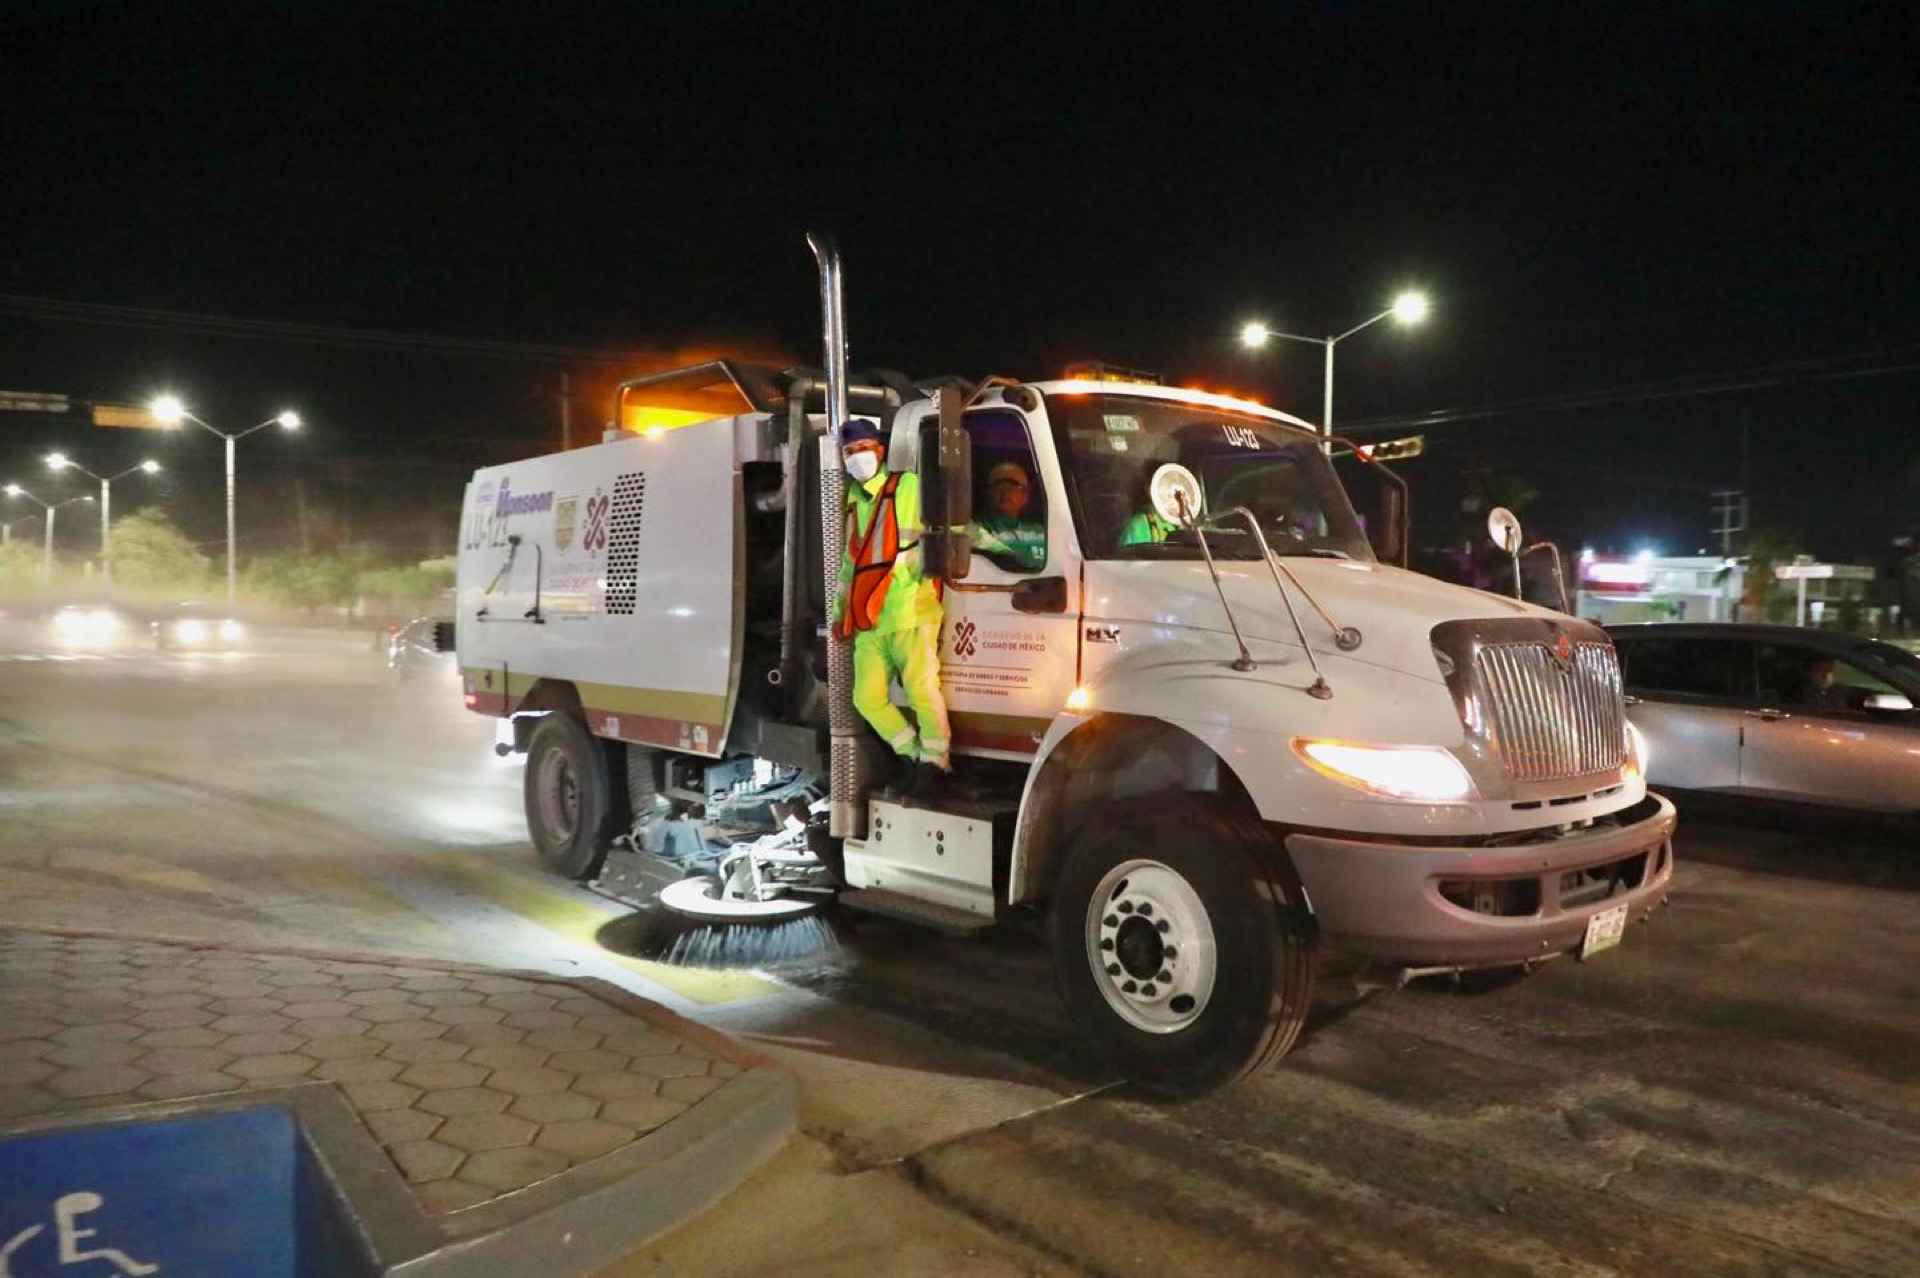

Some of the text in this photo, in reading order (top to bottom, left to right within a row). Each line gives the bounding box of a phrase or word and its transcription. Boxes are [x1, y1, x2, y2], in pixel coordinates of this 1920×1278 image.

[982, 630, 1046, 641] GOBIERNO DE LA
[982, 641, 1046, 652] CIUDAD DE MÉXICO
